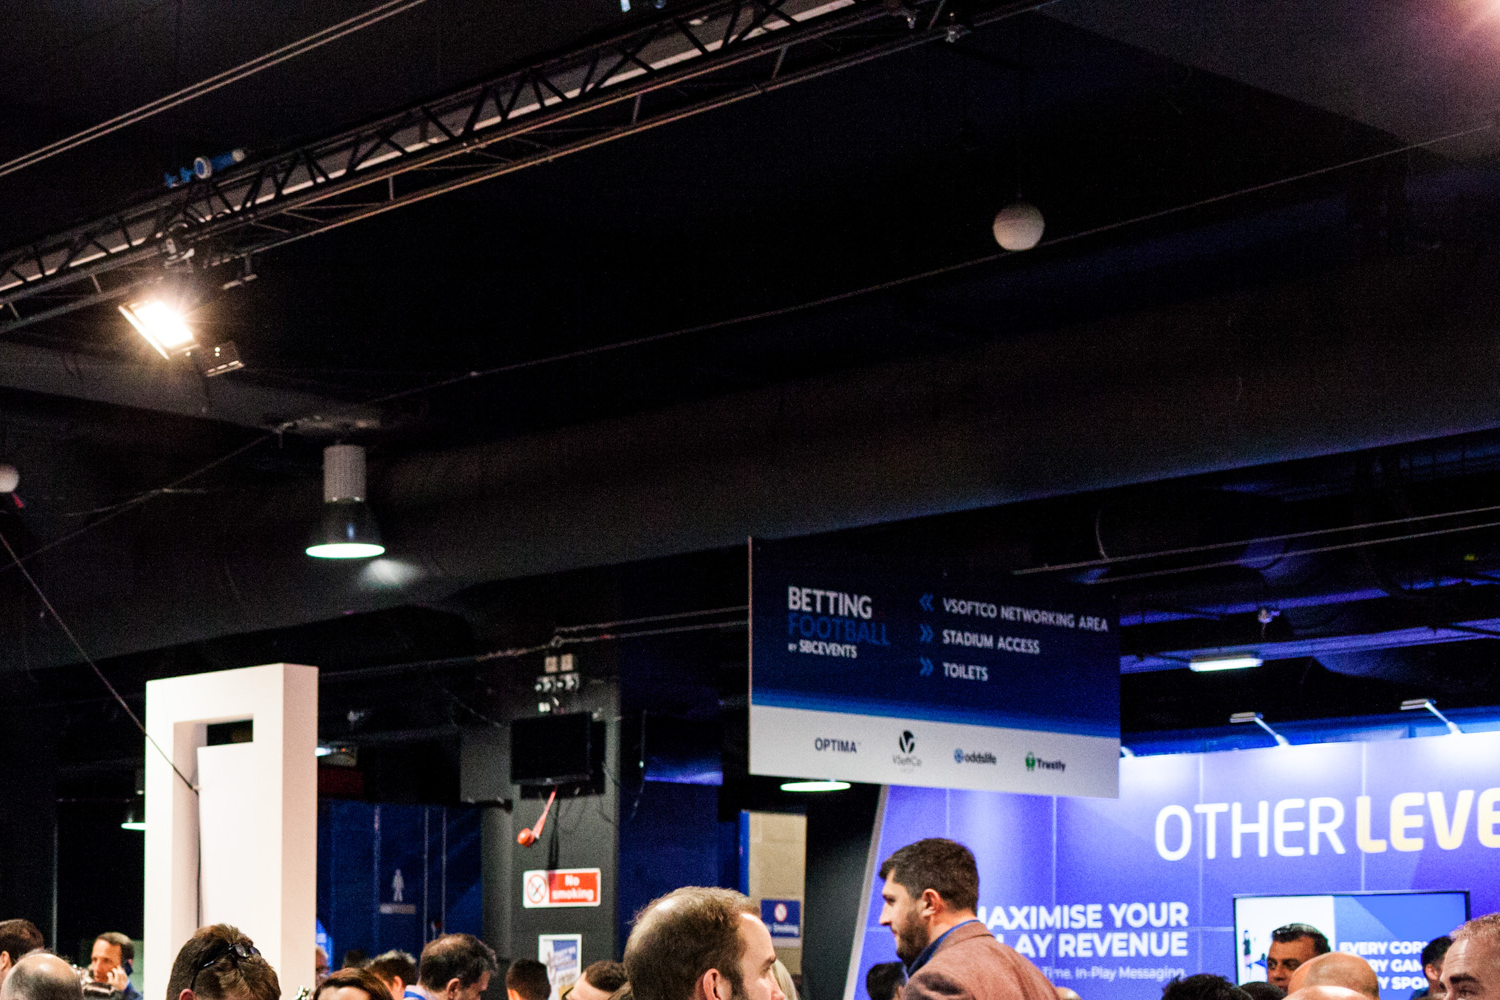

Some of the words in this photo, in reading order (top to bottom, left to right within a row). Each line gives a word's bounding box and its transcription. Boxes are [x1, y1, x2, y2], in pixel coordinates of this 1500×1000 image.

[787, 586, 873, 620] BETTING
[942, 598, 997, 618] VSOFTCO
[1001, 605, 1075, 629] NETWORKING
[1078, 615, 1109, 632] AREA
[787, 611, 891, 646] FOOTBALL
[799, 639, 858, 659] SBCEVENTS
[942, 629, 994, 649] STADIUM
[997, 636, 1040, 655] ACCESS
[942, 661, 989, 682] TOILETS
[814, 737, 858, 754] OPTIMA
[1036, 757, 1066, 773] Trustly
[564, 874, 581, 887] No
[551, 887, 595, 902] smoking
[1108, 901, 1189, 928] YOUR
[1058, 931, 1189, 958] REVENUE
[1075, 965, 1117, 982] In-Play
